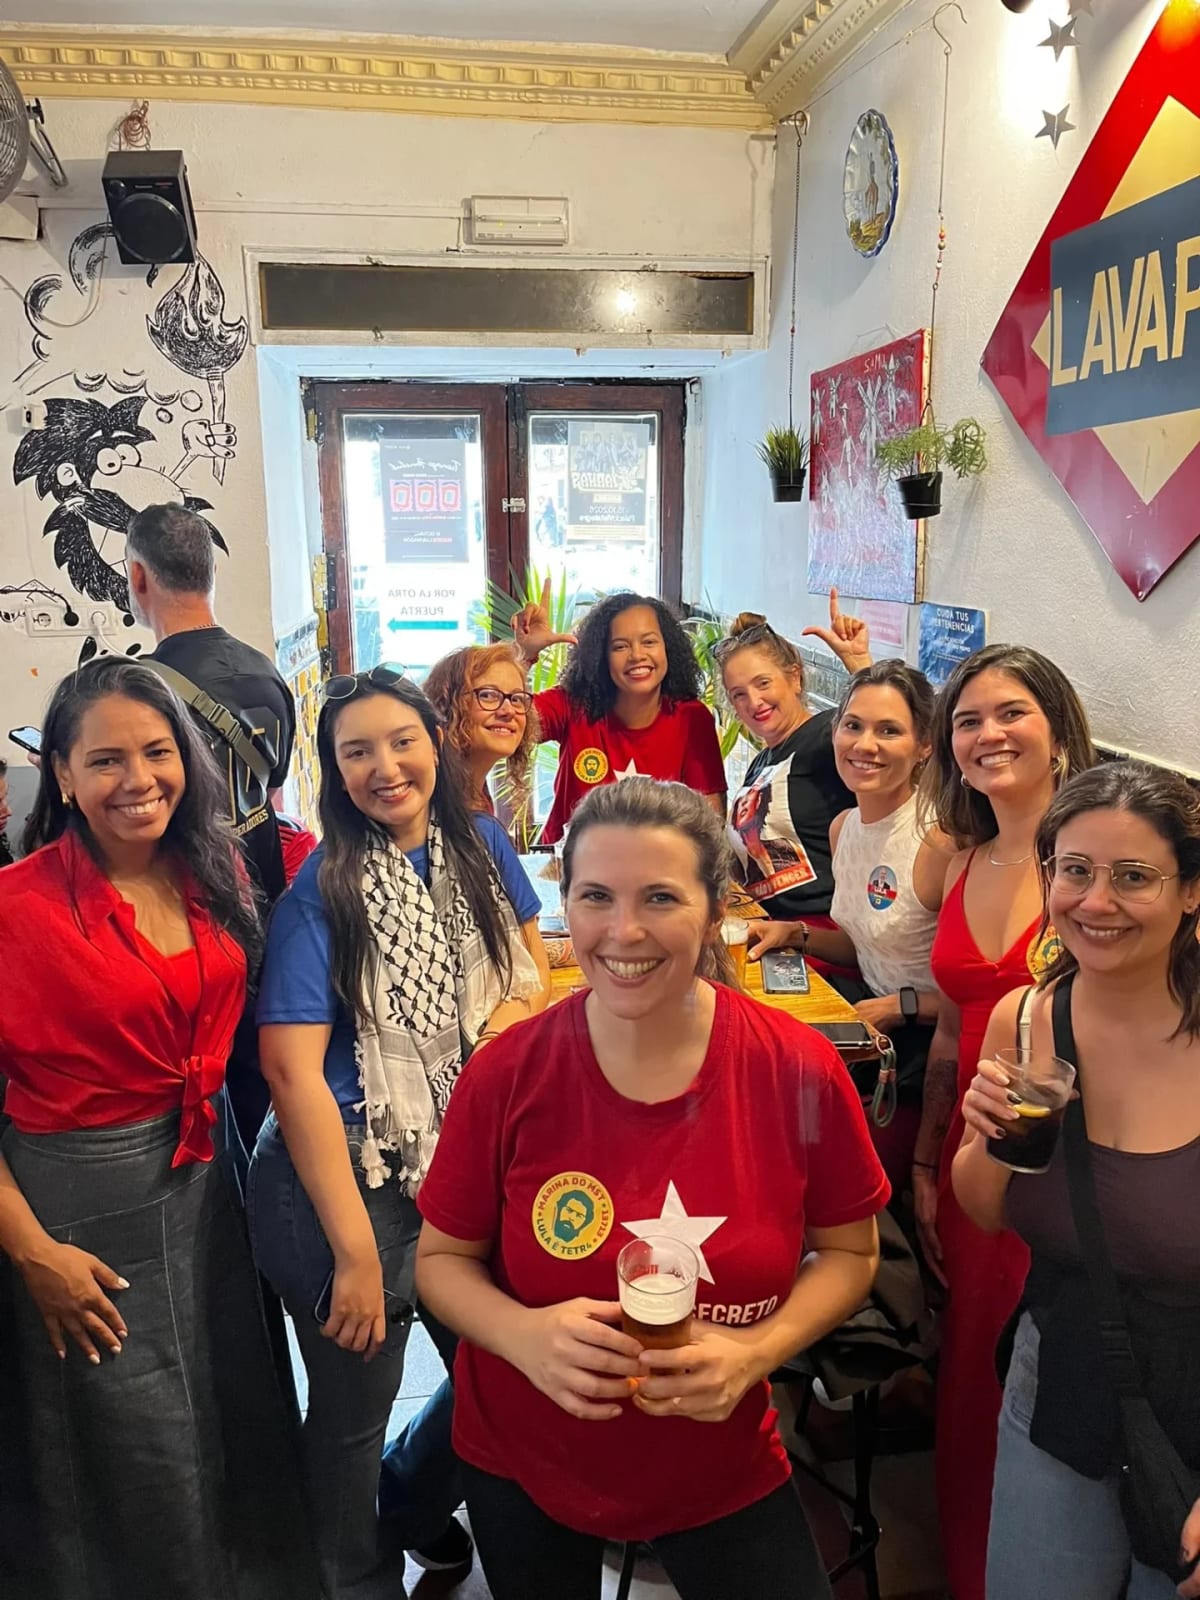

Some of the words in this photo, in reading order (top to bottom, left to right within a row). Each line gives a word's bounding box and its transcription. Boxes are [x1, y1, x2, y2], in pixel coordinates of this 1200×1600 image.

[955, 611, 969, 622] TUS
[538, 1178, 570, 1210] MARINA
[572, 1177, 586, 1187] DO
[587, 1182, 606, 1201] MST
[537, 1218, 552, 1245] LULA
[596, 1209, 609, 1238] 13713
